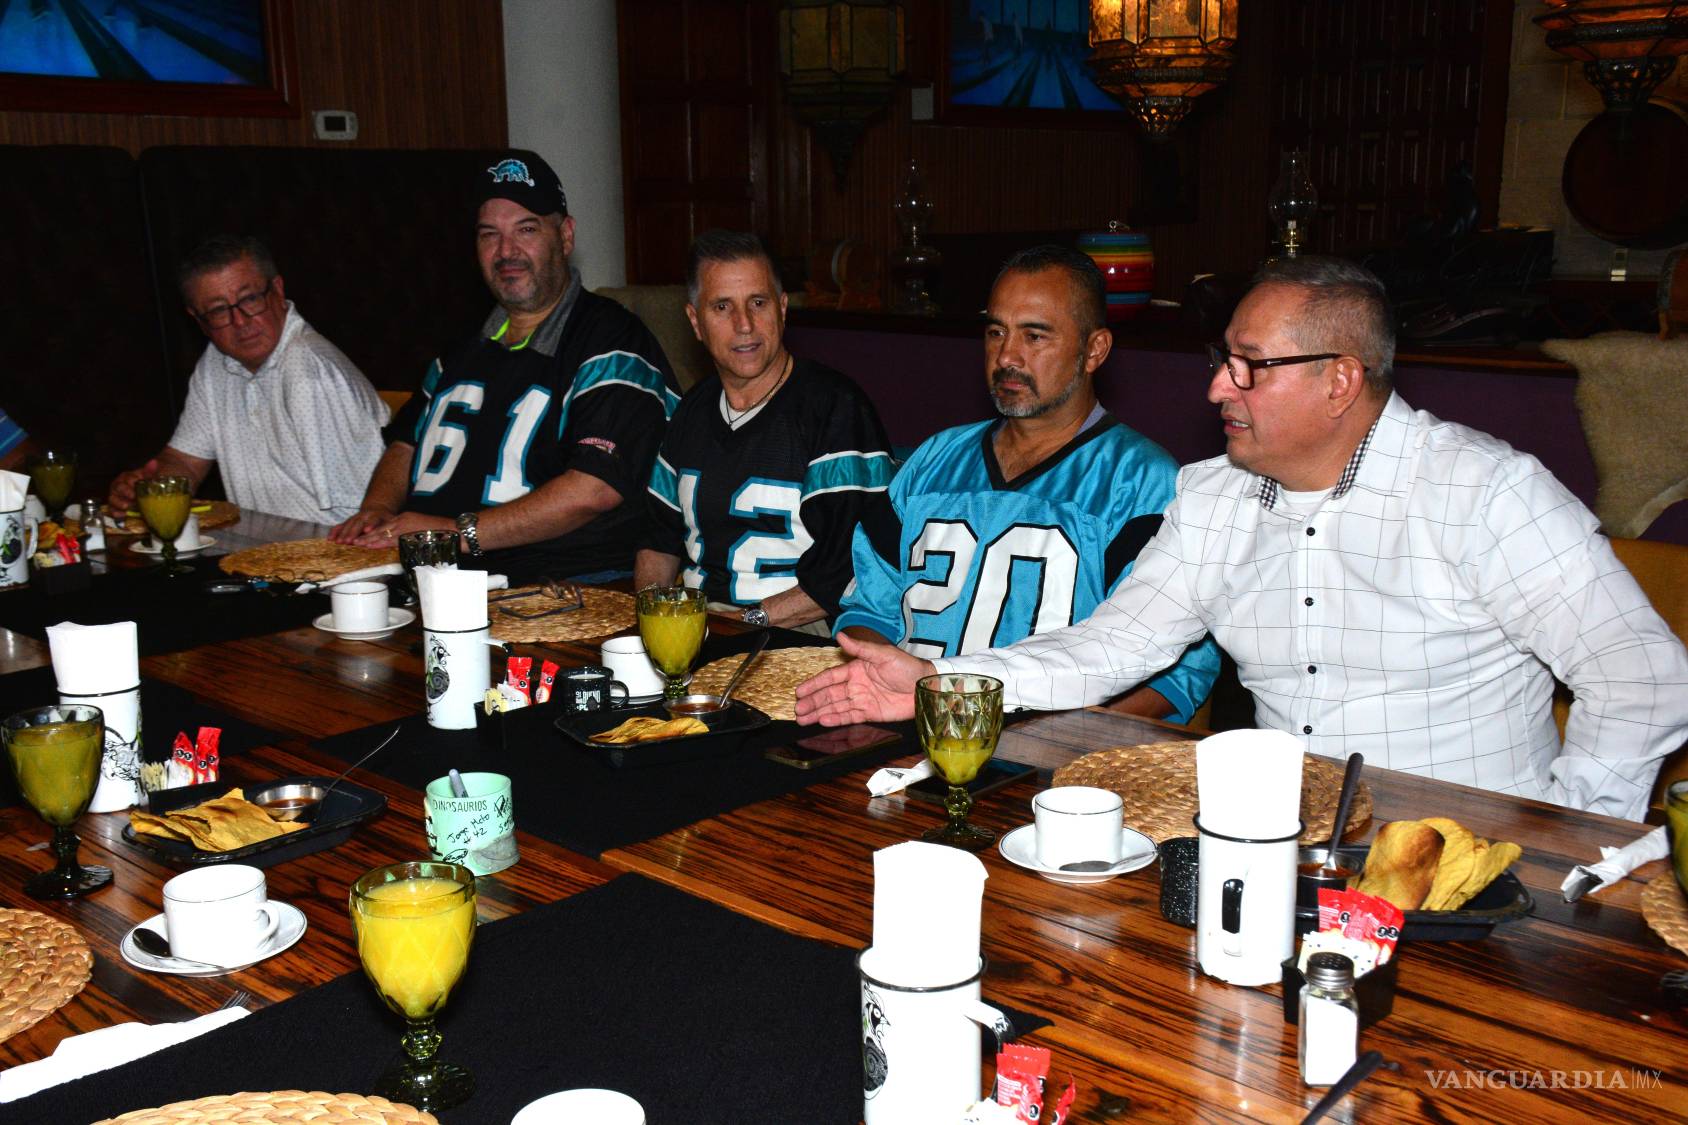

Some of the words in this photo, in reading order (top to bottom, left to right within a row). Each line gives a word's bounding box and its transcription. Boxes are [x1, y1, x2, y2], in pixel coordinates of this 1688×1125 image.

[413, 384, 553, 505] 61
[677, 469, 816, 602] 12
[901, 518, 1080, 660] 20
[434, 800, 488, 813] DINOSAURIOS
